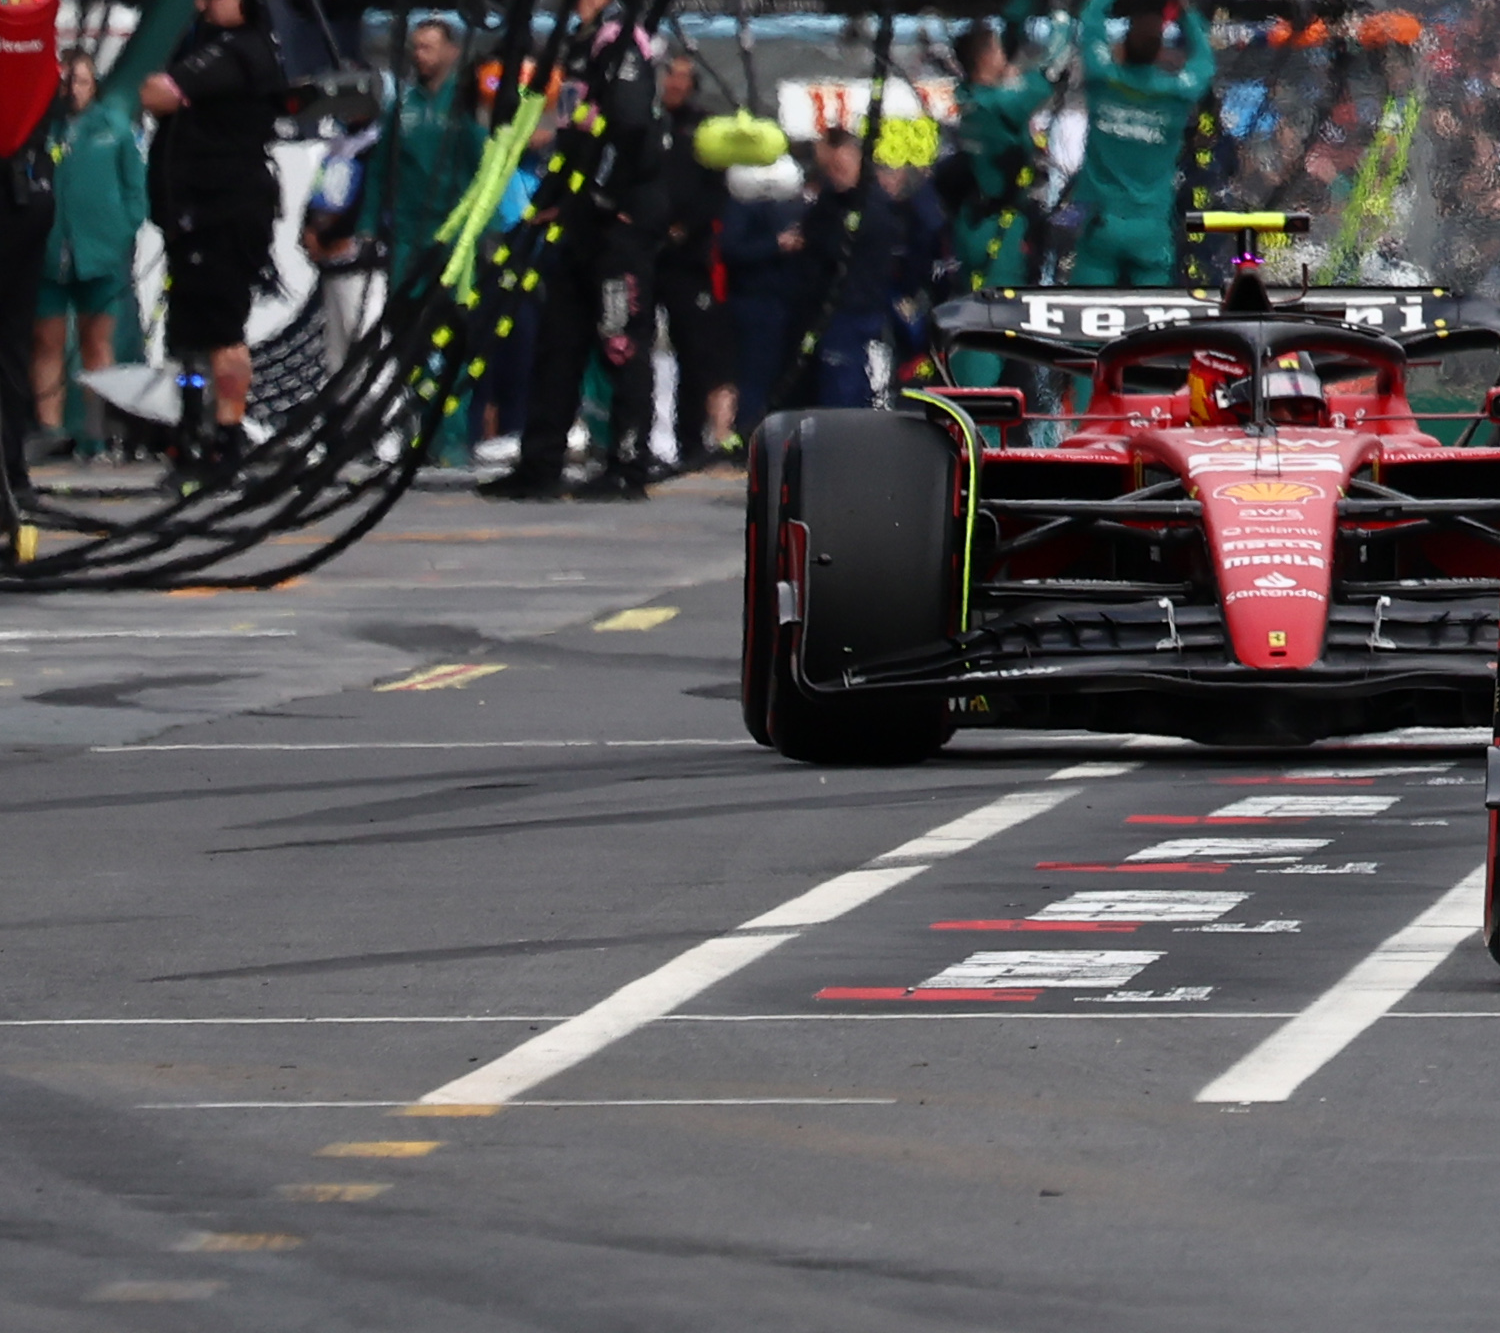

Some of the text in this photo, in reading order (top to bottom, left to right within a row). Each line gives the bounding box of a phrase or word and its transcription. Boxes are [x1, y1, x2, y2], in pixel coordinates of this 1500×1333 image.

[1187, 453, 1343, 478] 55
[1239, 509, 1304, 522] aws
[1223, 554, 1326, 569] MAHLE
[1226, 589, 1327, 604] Santander
